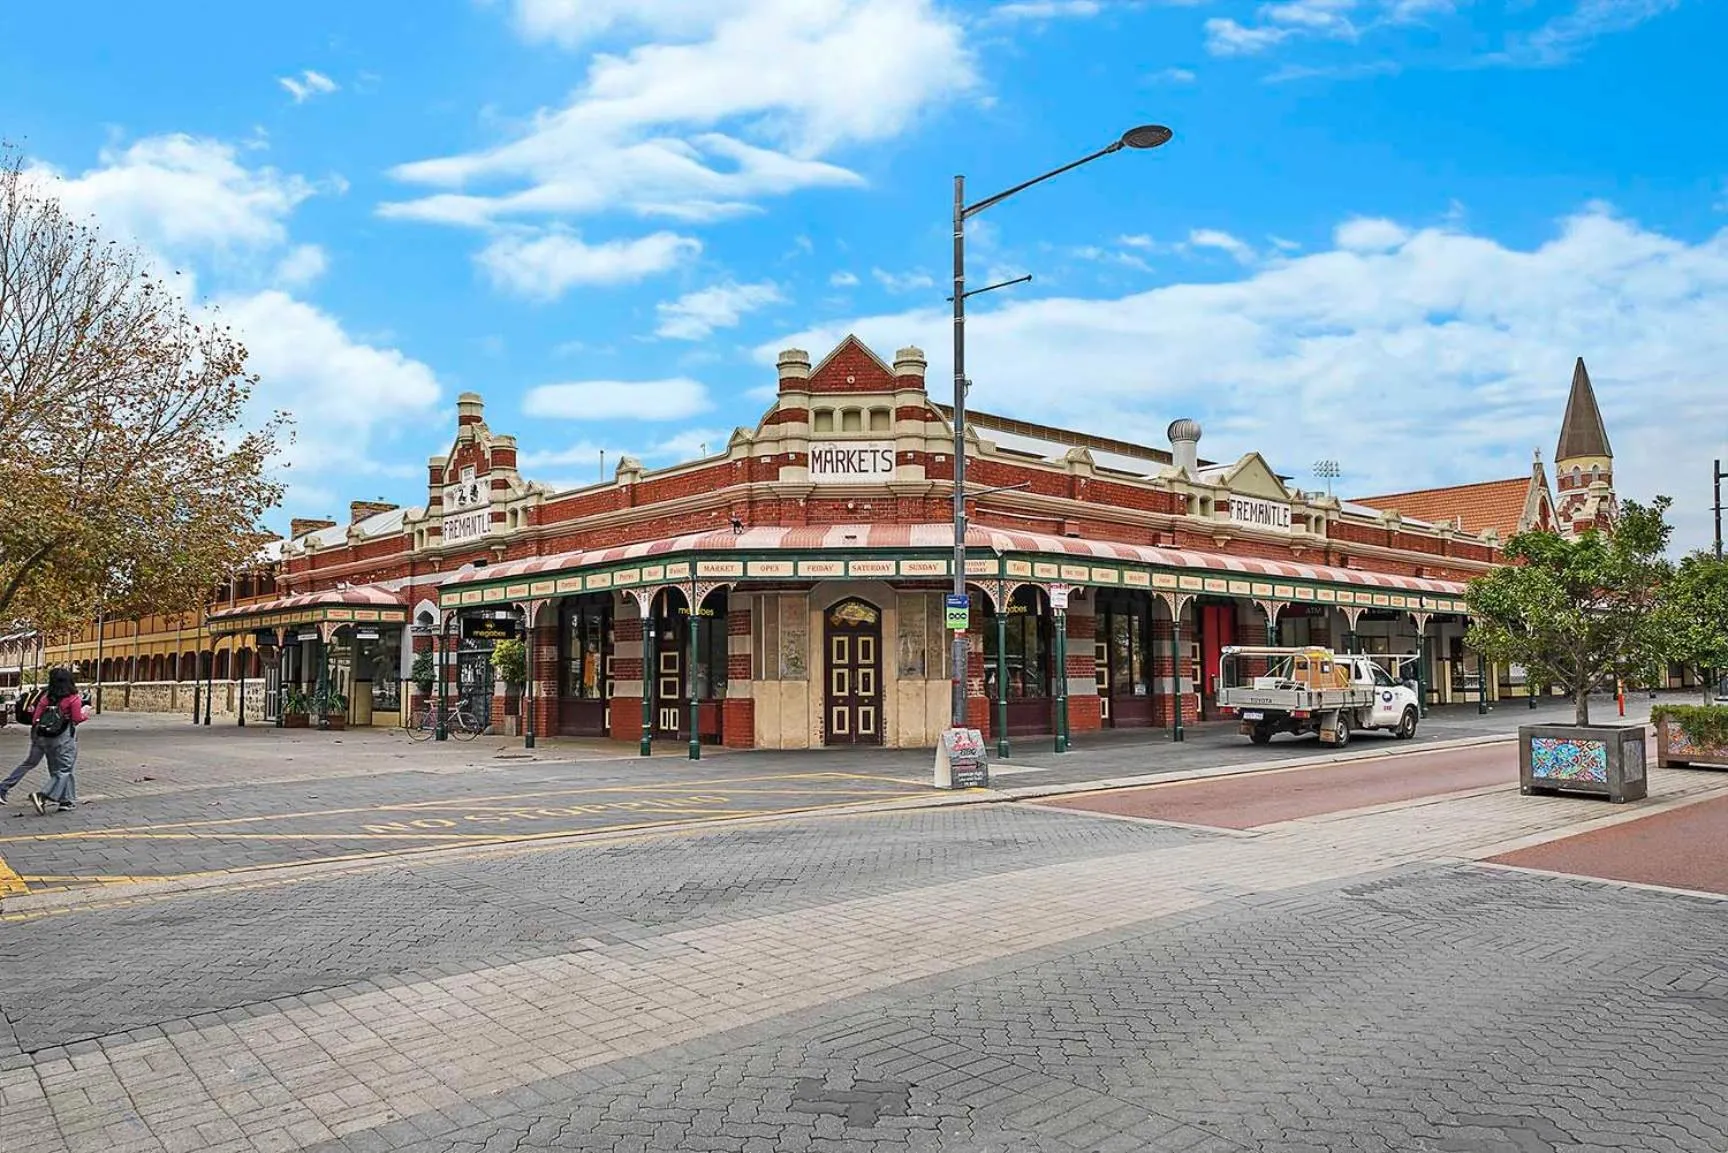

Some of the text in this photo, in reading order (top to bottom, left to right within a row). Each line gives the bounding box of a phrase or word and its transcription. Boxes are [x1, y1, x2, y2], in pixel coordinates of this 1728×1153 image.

[811, 449, 893, 473] MARKETS
[1229, 499, 1289, 528] FREMANTLE
[704, 563, 938, 572] MARKET OPEN FRIDAY SATURDAY SUNDAY
[364, 817, 457, 834] NO
